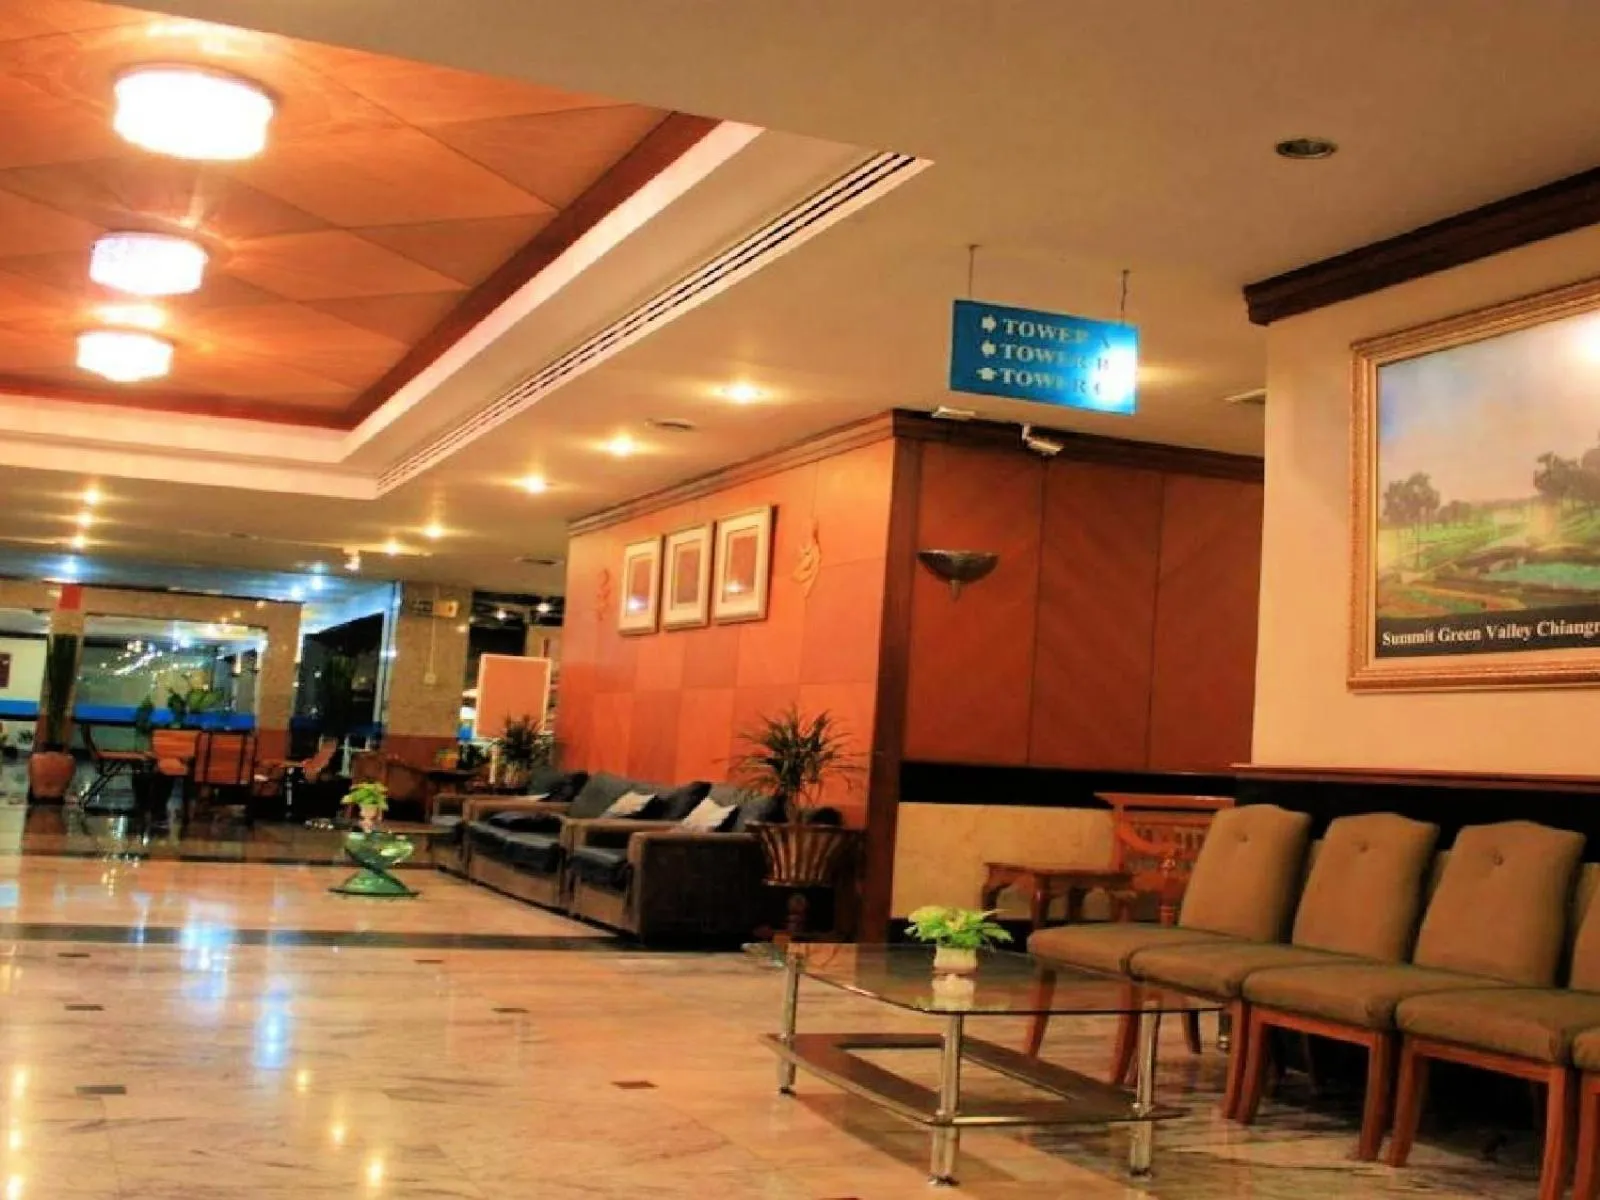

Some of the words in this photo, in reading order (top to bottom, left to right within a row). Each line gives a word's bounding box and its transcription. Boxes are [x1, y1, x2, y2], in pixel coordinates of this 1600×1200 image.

[1382, 629, 1434, 646] Summit
[1438, 625, 1481, 642] Green
[1486, 623, 1532, 641] Valley
